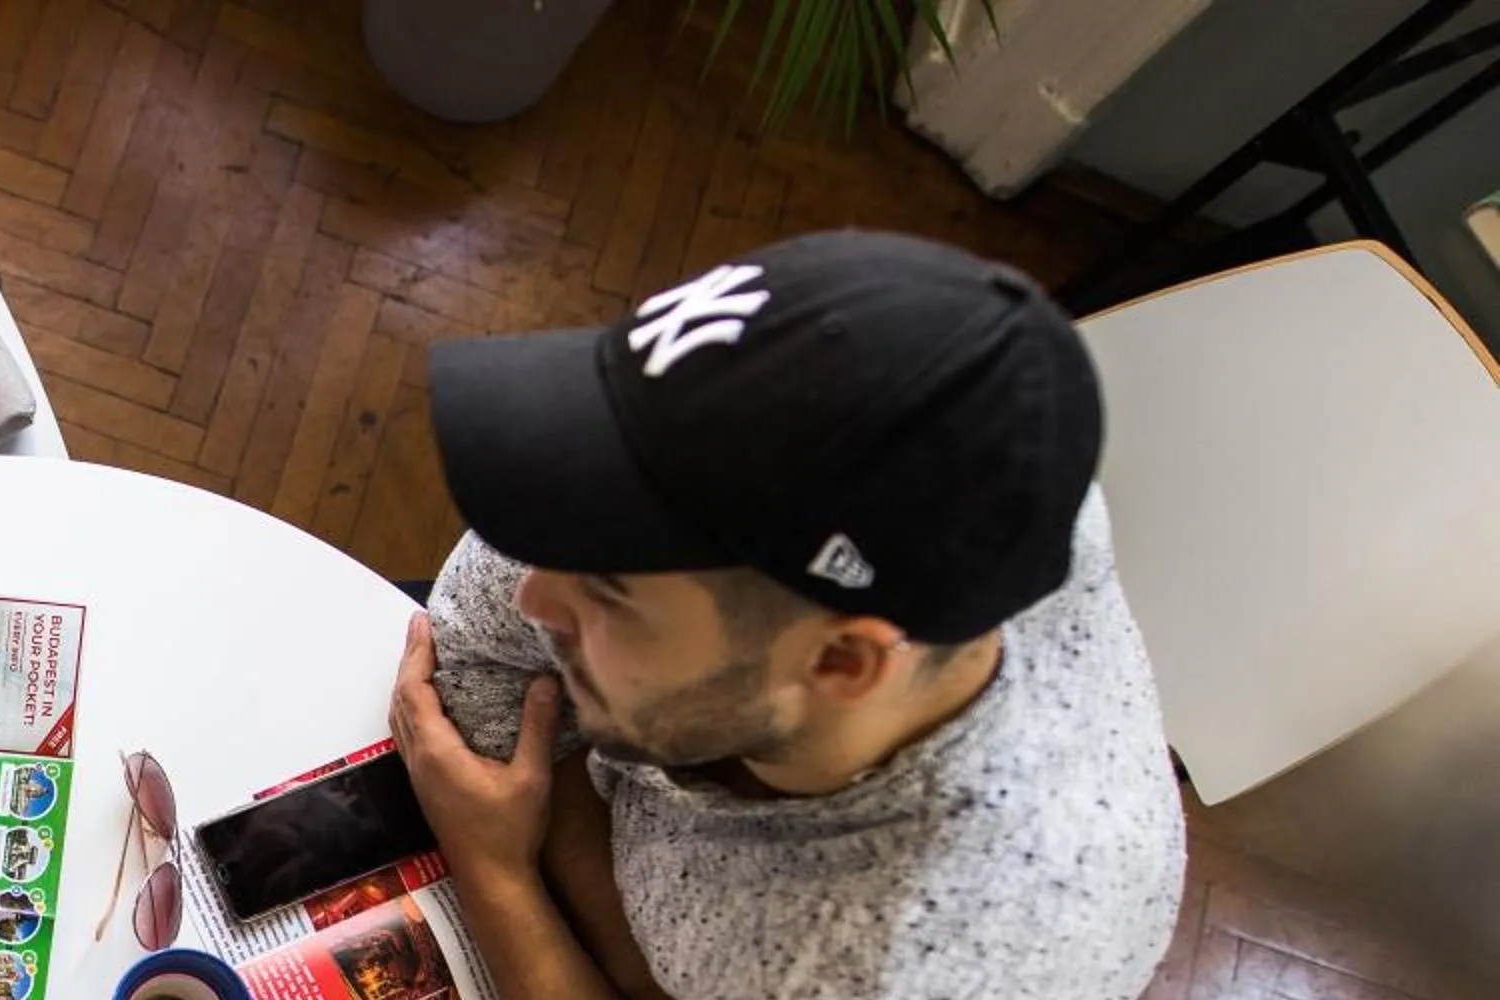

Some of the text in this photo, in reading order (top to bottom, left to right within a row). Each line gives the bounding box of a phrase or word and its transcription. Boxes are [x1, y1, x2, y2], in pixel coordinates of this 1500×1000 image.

[22, 613, 45, 726] YOUR POCKET!
[41, 615, 62, 716] BUDAPEST IN
[48, 724, 67, 750] FREE
